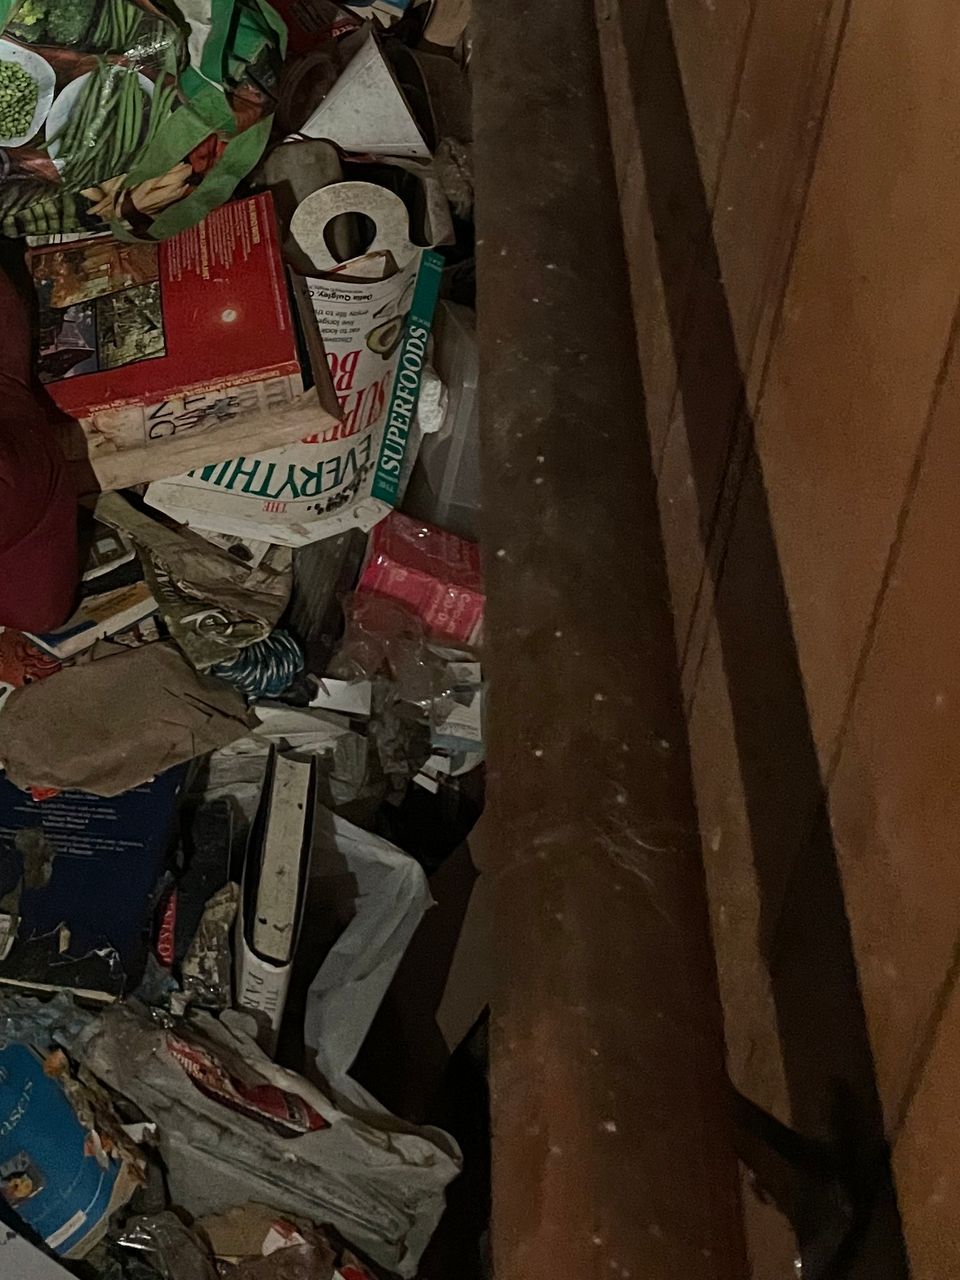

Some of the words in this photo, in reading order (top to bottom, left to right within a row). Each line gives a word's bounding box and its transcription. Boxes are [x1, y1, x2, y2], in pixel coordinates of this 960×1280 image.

[315, 289, 351, 302] Quigley,
[334, 309, 347, 317] life
[316, 316, 340, 325] longe
[341, 318, 354, 327] live
[318, 343, 362, 394] BO
[380, 325, 429, 474] SUPERFOODS
[187, 434, 375, 499] EVERYTHI
[262, 500, 289, 514] THE
